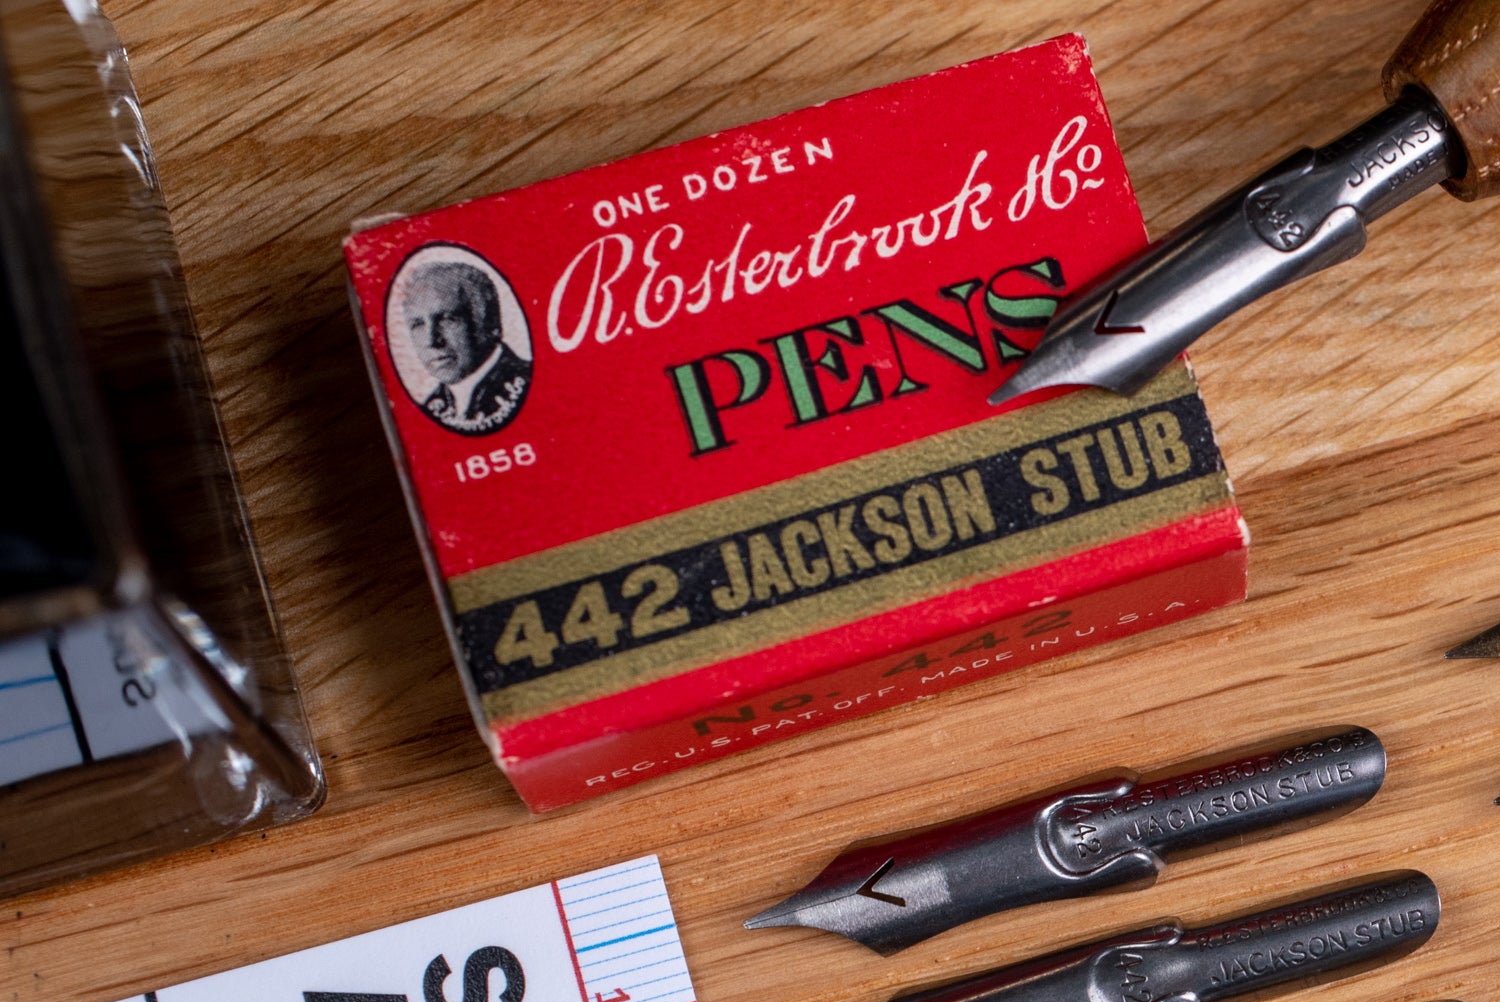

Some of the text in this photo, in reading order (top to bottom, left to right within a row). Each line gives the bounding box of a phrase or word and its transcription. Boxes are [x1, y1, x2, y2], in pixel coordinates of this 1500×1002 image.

[592, 137, 834, 227] ONE DOZEN
[665, 256, 1066, 459] PENS
[454, 443, 536, 482] 1858
[494, 410, 1192, 669] 442 JACKSON STUB
[881, 609, 1073, 679] 442
[921, 651, 1014, 684] MADE
[1031, 636, 1060, 651] IN
[1125, 761, 1355, 843] JACKSON STUB
[1210, 908, 1427, 987] JACKSON STUB
